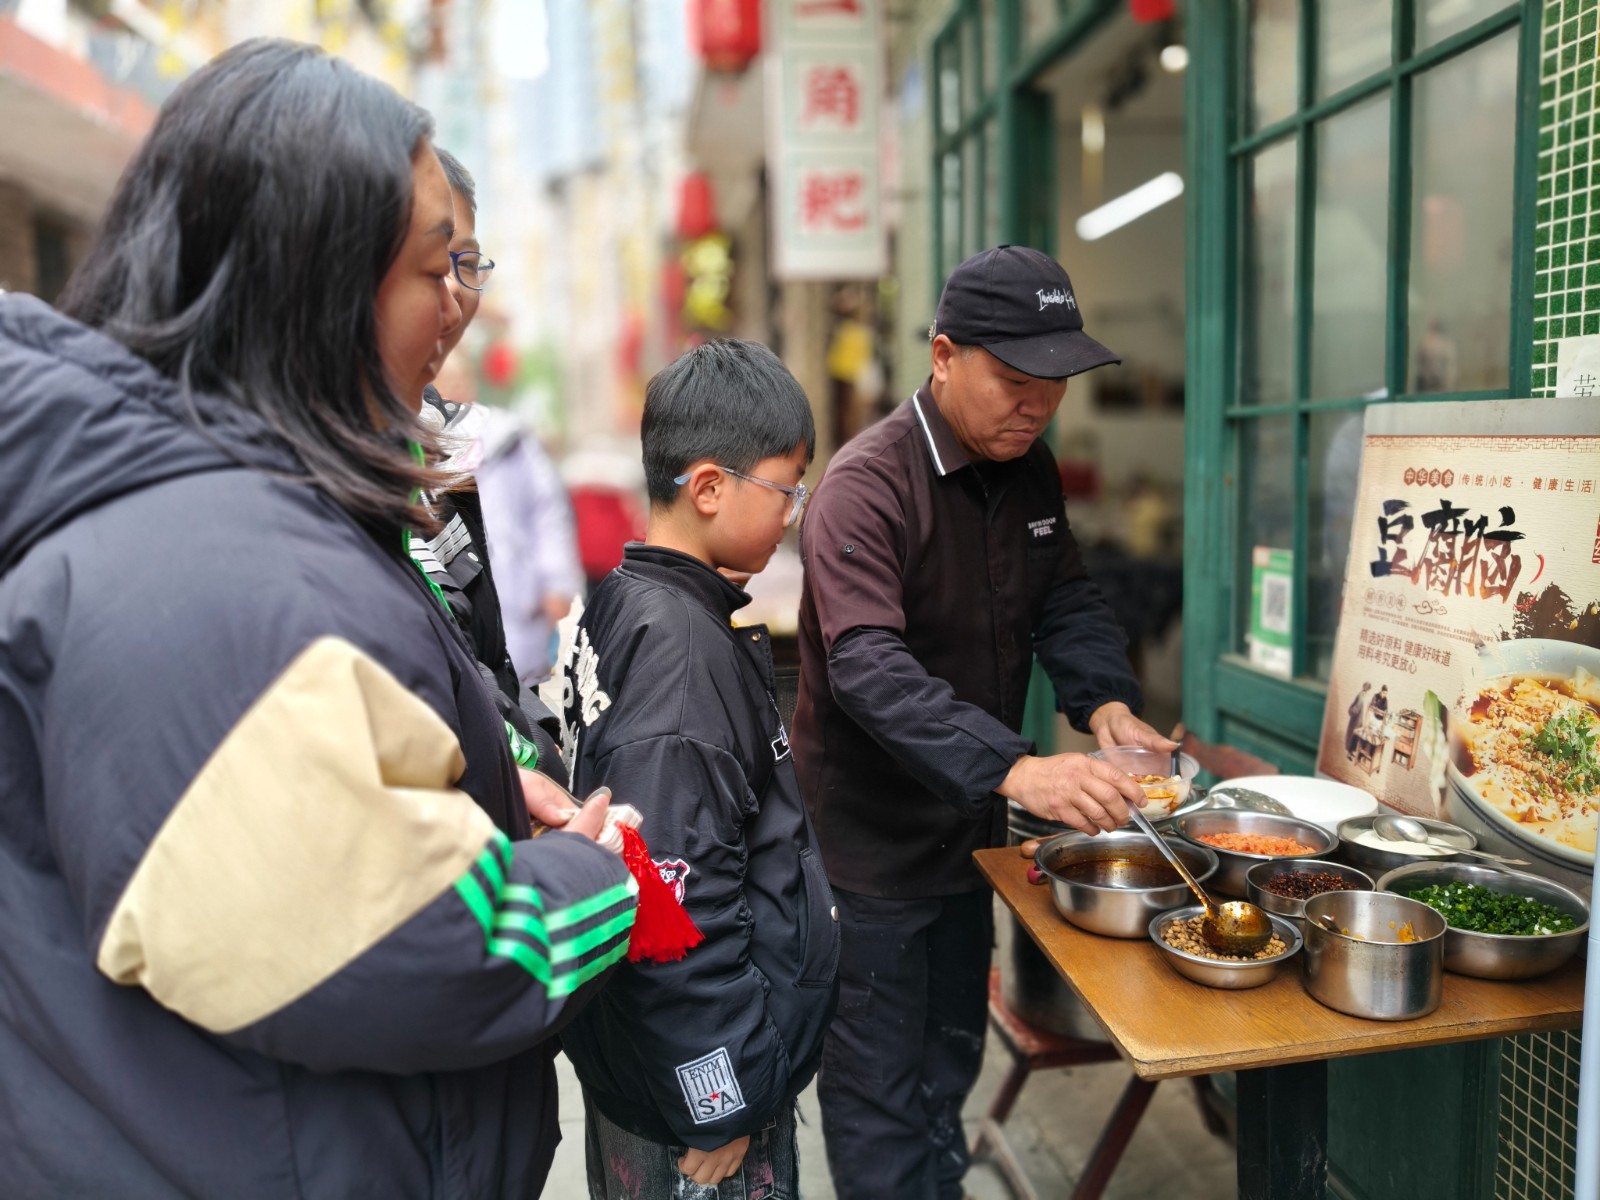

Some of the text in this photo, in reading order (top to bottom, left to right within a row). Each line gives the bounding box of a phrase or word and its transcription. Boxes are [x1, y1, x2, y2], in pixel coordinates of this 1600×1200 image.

[796, 0, 868, 232] 角粑
[1404, 467, 1592, 493] 中华美食 传统小吃 健康生活
[1033, 526, 1053, 537] FEEL
[1370, 499, 1526, 603] 豆腐脑
[1357, 645, 1418, 675] 用料考究更放心
[1359, 628, 1452, 667] 精选好原料 健康好味道
